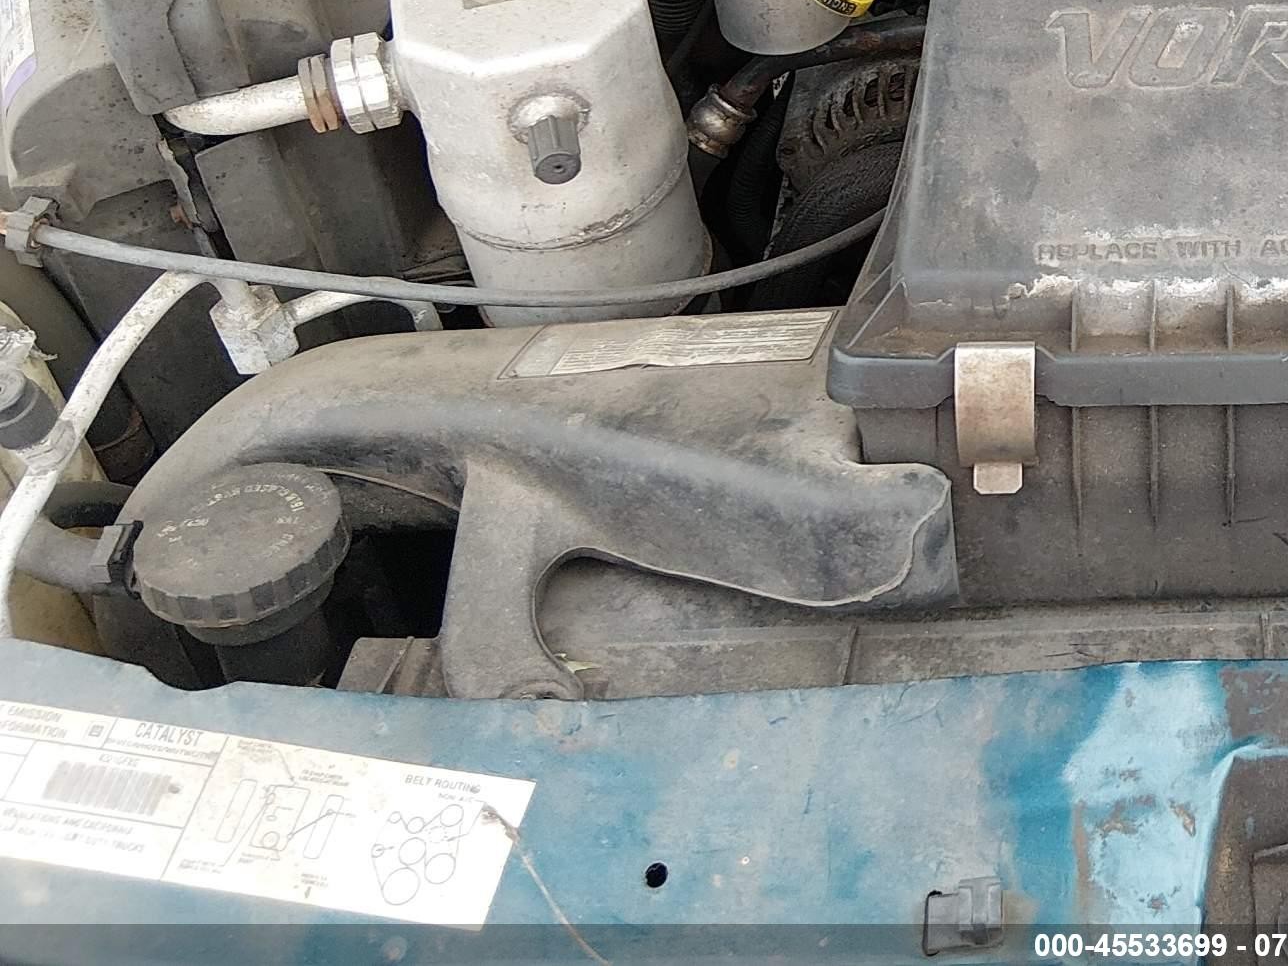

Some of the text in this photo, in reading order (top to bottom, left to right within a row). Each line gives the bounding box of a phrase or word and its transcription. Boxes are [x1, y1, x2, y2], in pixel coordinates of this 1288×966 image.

[1037, 241, 1158, 262] REPLACE
[1176, 239, 1241, 259] WITH
[135, 722, 204, 748] CATALYST
[405, 774, 433, 787] BELT
